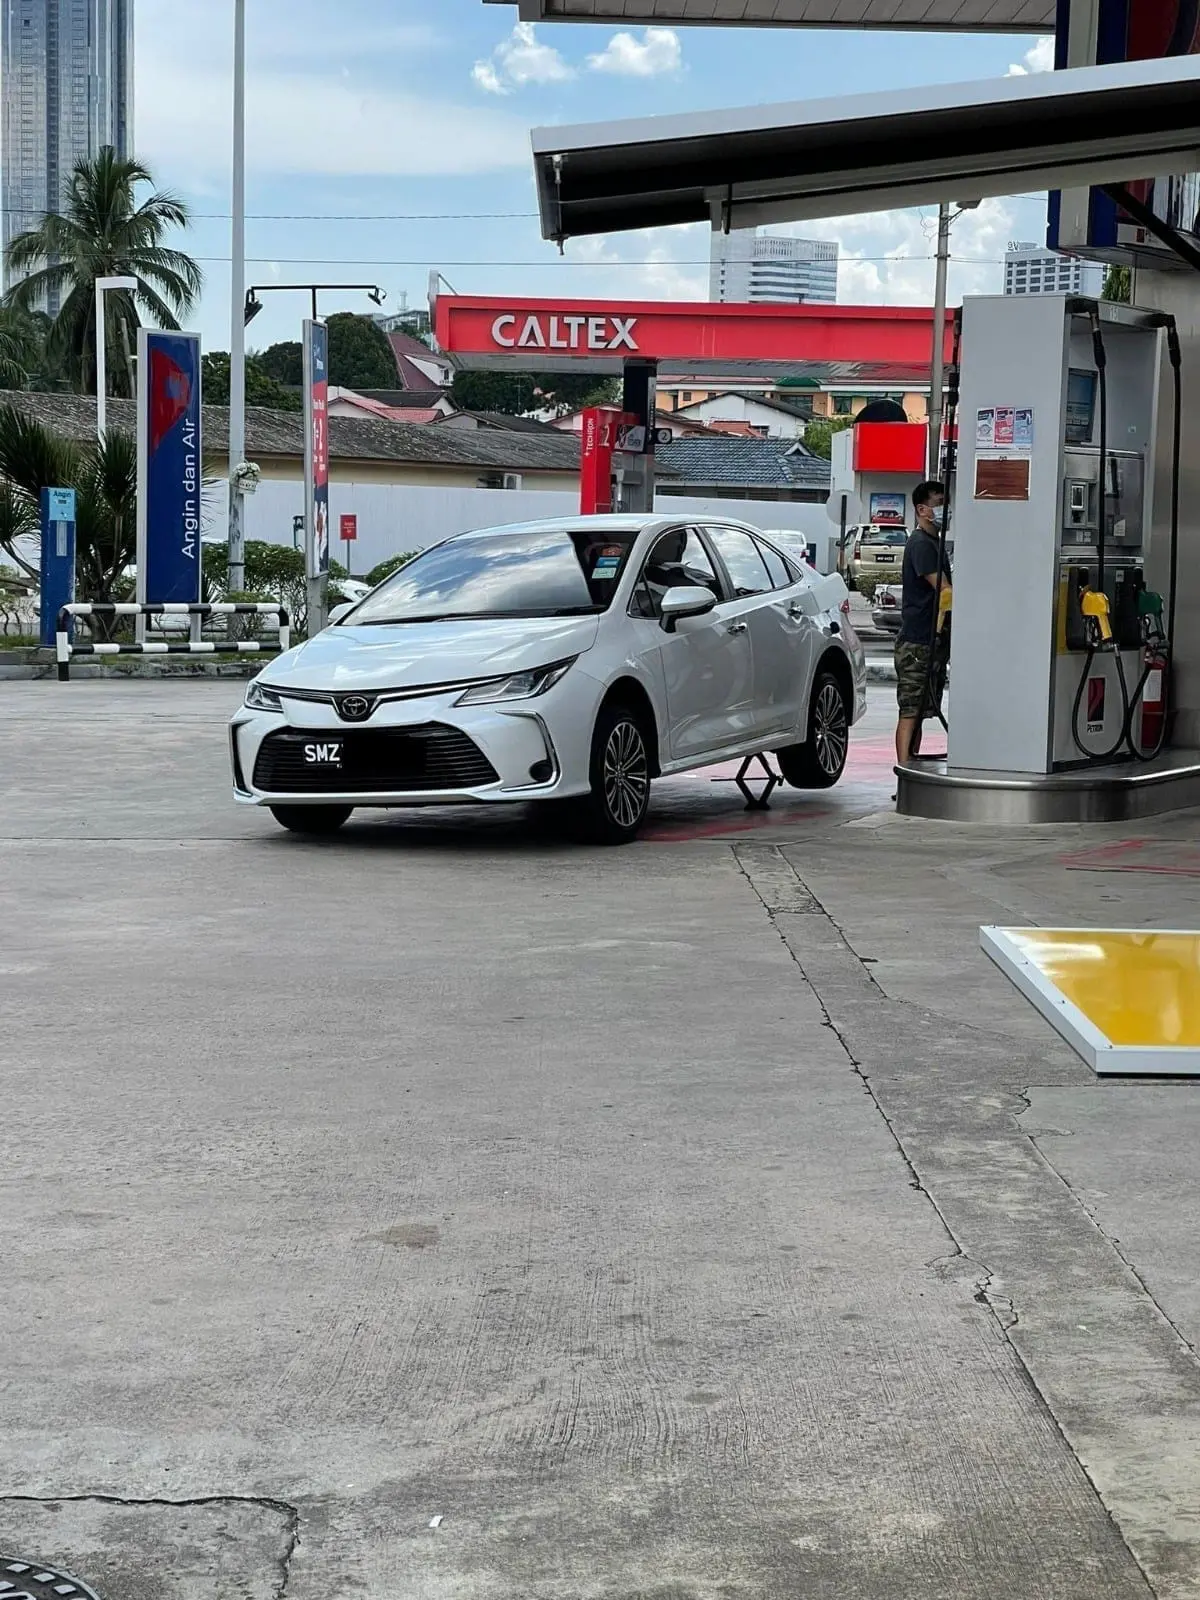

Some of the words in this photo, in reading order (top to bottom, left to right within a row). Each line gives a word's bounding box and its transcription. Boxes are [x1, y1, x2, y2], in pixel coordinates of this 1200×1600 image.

[491, 315, 639, 350] CALTEX
[181, 418, 196, 449] Air
[182, 455, 196, 494] dan
[181, 498, 198, 559] Angin
[1087, 724, 1104, 733] PETRON
[304, 743, 340, 762] SMZ
